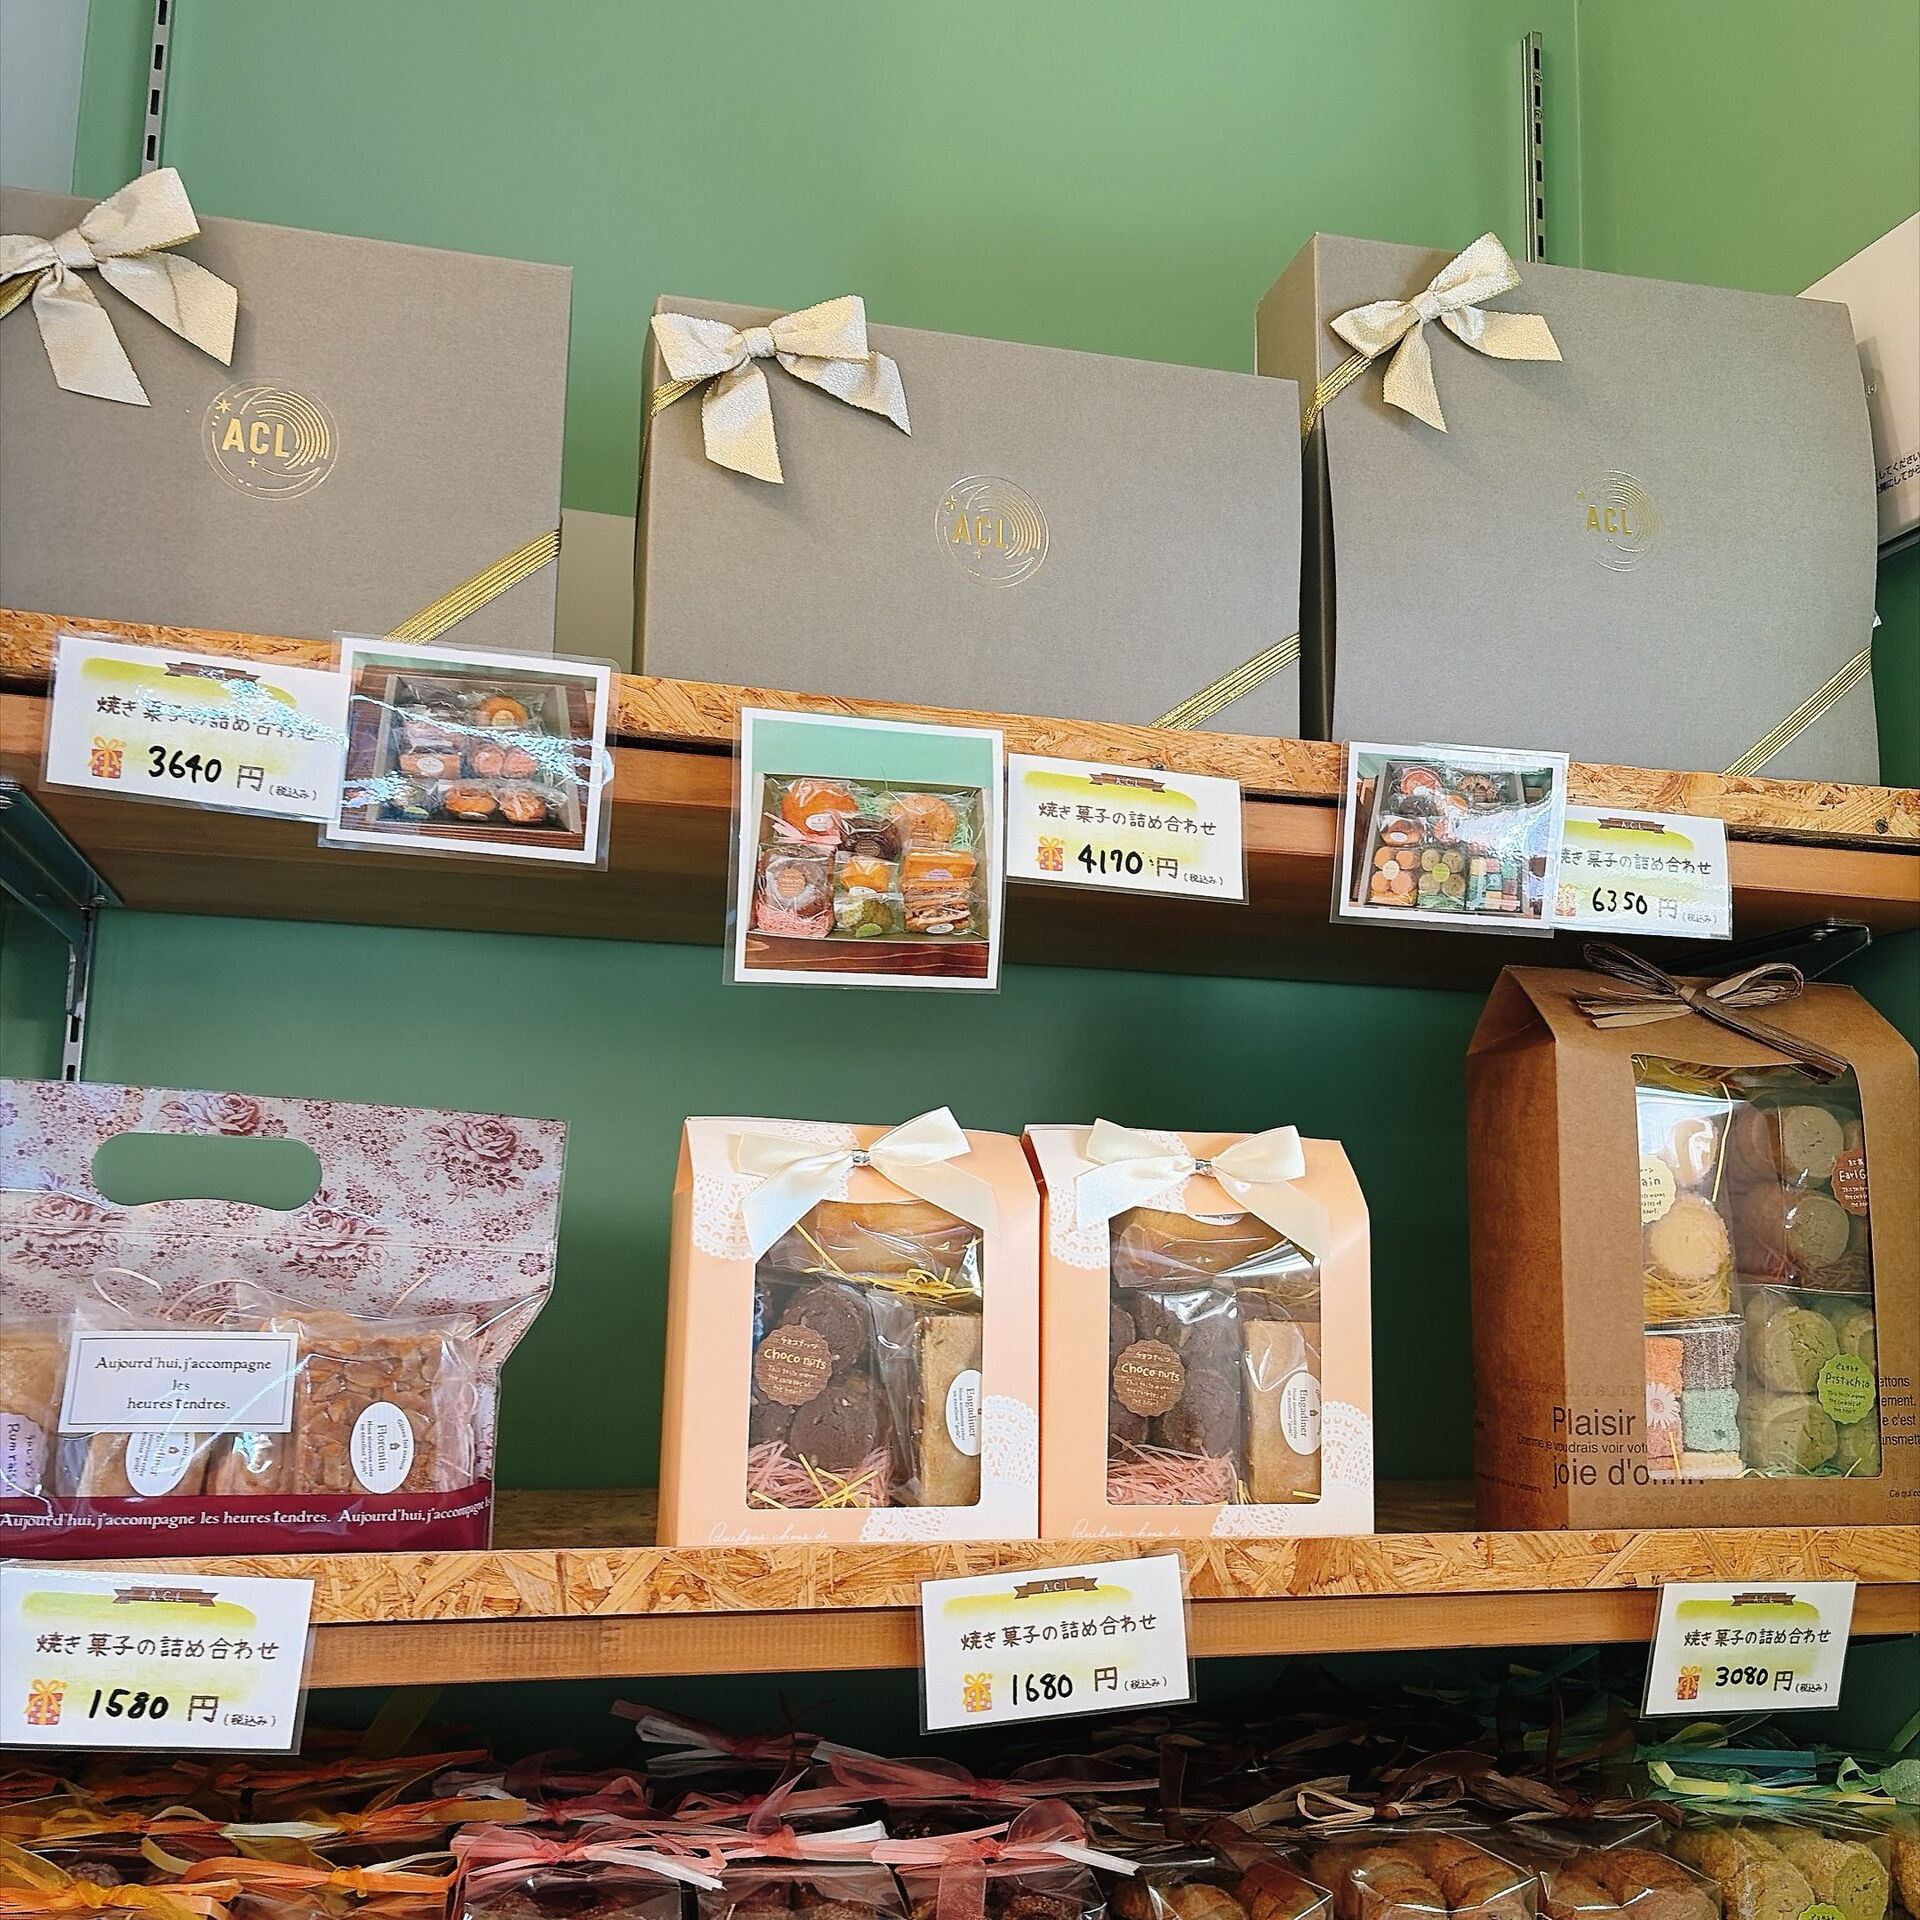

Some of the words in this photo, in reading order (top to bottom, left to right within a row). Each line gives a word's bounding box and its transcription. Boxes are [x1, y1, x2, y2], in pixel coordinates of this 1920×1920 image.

[221, 417, 290, 458] ACL
[952, 512, 1009, 550] ACL
[1585, 504, 1633, 536] ACL
[147, 745, 222, 784] 3640
[236, 764, 265, 792] 円
[1038, 801, 1217, 836] 焼き菓子の詰め合わせ
[1077, 843, 1143, 875] 4170
[1156, 856, 1179, 880] 円
[1591, 886, 1648, 915] 6350
[1658, 898, 1678, 920] 円
[1839, 1169, 1858, 1182] Earl
[763, 1348, 800, 1364] Choco
[802, 1357, 827, 1370] nuts
[1121, 1363, 1155, 1377] Choco
[1158, 1369, 1181, 1382] nuts
[171, 1379, 191, 1391] les
[1825, 1372, 1870, 1388] Pistachio
[126, 1397, 173, 1410] heures
[174, 1397, 231, 1410] tendres.
[965, 1387, 977, 1438] Engadiner
[1298, 1389, 1309, 1437] Engadiner
[7, 1423, 20, 1451] Rum
[1552, 1406, 1637, 1436] Plaisir
[377, 1424, 389, 1471] Florentin
[1601, 1442, 1624, 1453] voir
[1552, 1456, 1597, 1489] joie
[199, 1511, 220, 1524] les
[222, 1510, 271, 1524] heures
[272, 1509, 332, 1524] tendres.
[36, 1631, 280, 1660] 焼き菓子の詰め合わせ
[959, 1614, 1158, 1651] 焼き菓子の詰め合わせ
[1683, 1627, 1832, 1648] 焼き菓子の詰め合わせ
[1012, 1672, 1074, 1706] 1680
[1093, 1666, 1118, 1692] 円
[1714, 1665, 1769, 1688] 3080
[1773, 1670, 1794, 1691] 円
[88, 1688, 170, 1720] 1580
[187, 1695, 220, 1723] 円
